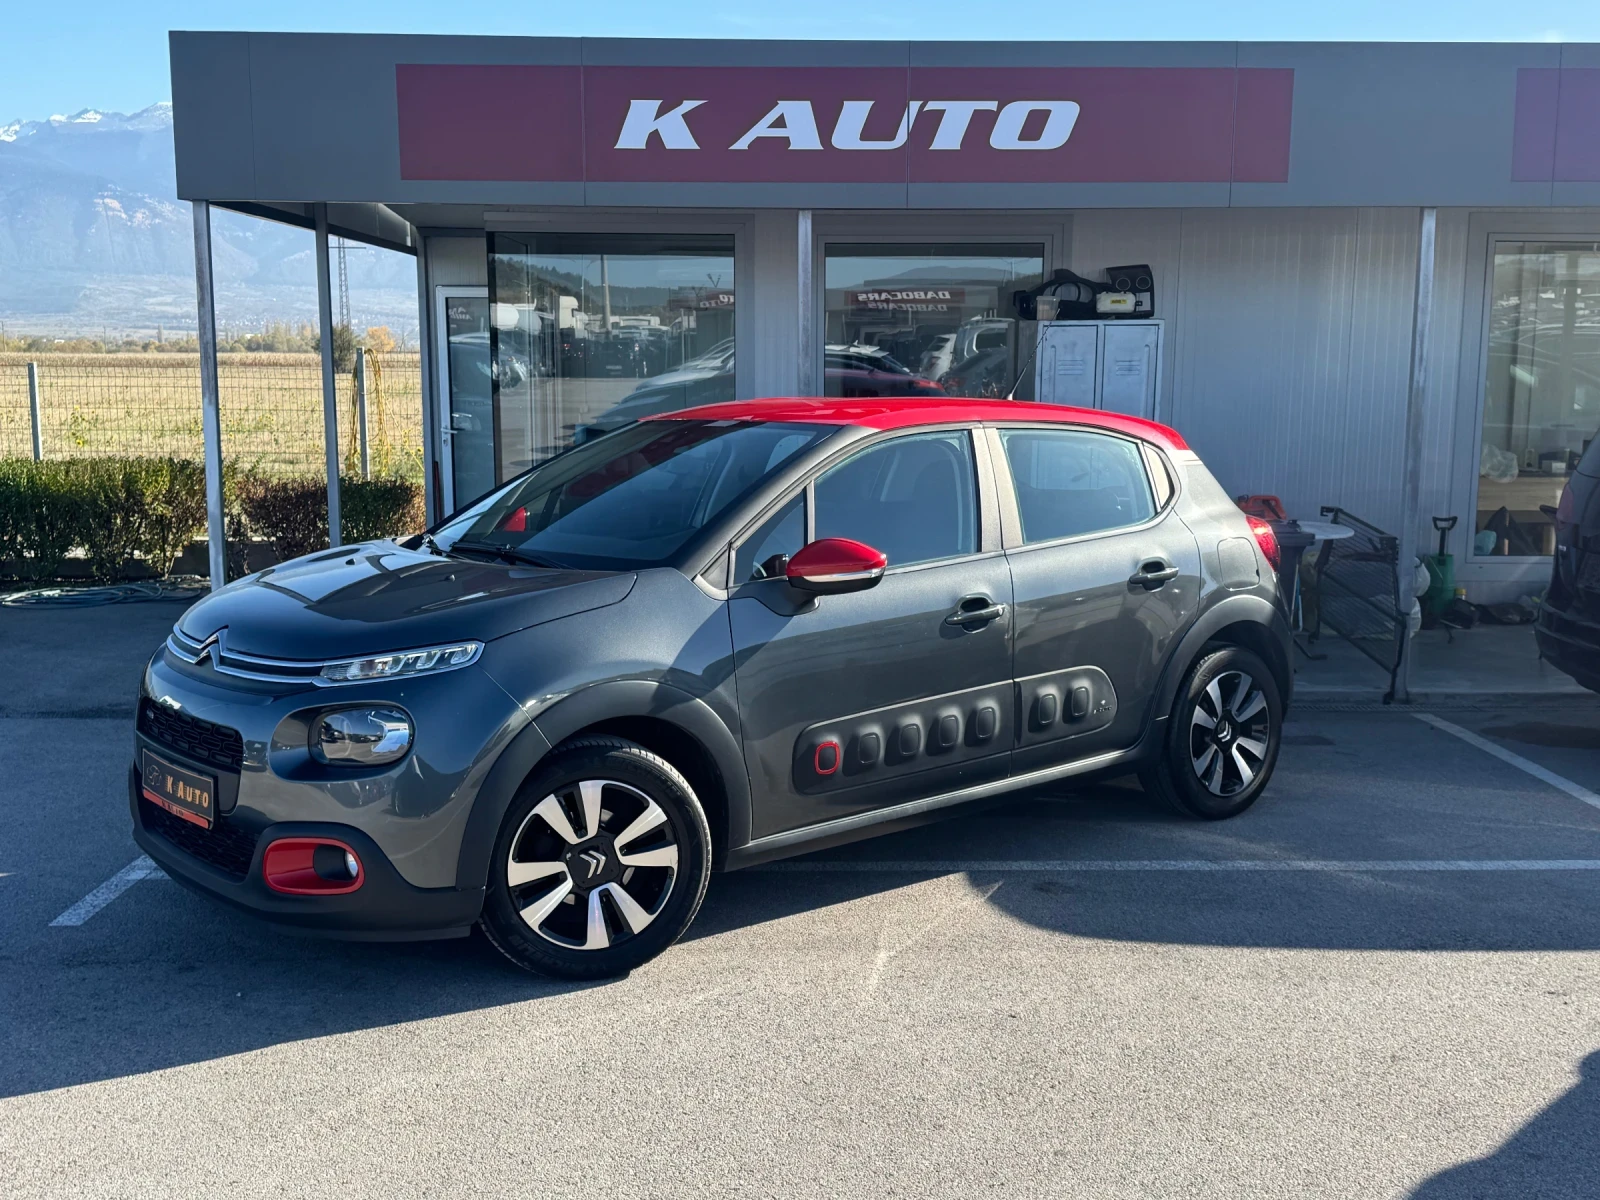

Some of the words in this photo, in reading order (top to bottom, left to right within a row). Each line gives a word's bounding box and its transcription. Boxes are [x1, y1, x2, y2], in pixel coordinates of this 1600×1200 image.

[613, 100, 709, 150] K
[728, 100, 1081, 150] AUTO
[167, 775, 174, 794] K
[178, 781, 209, 808] AUTO
